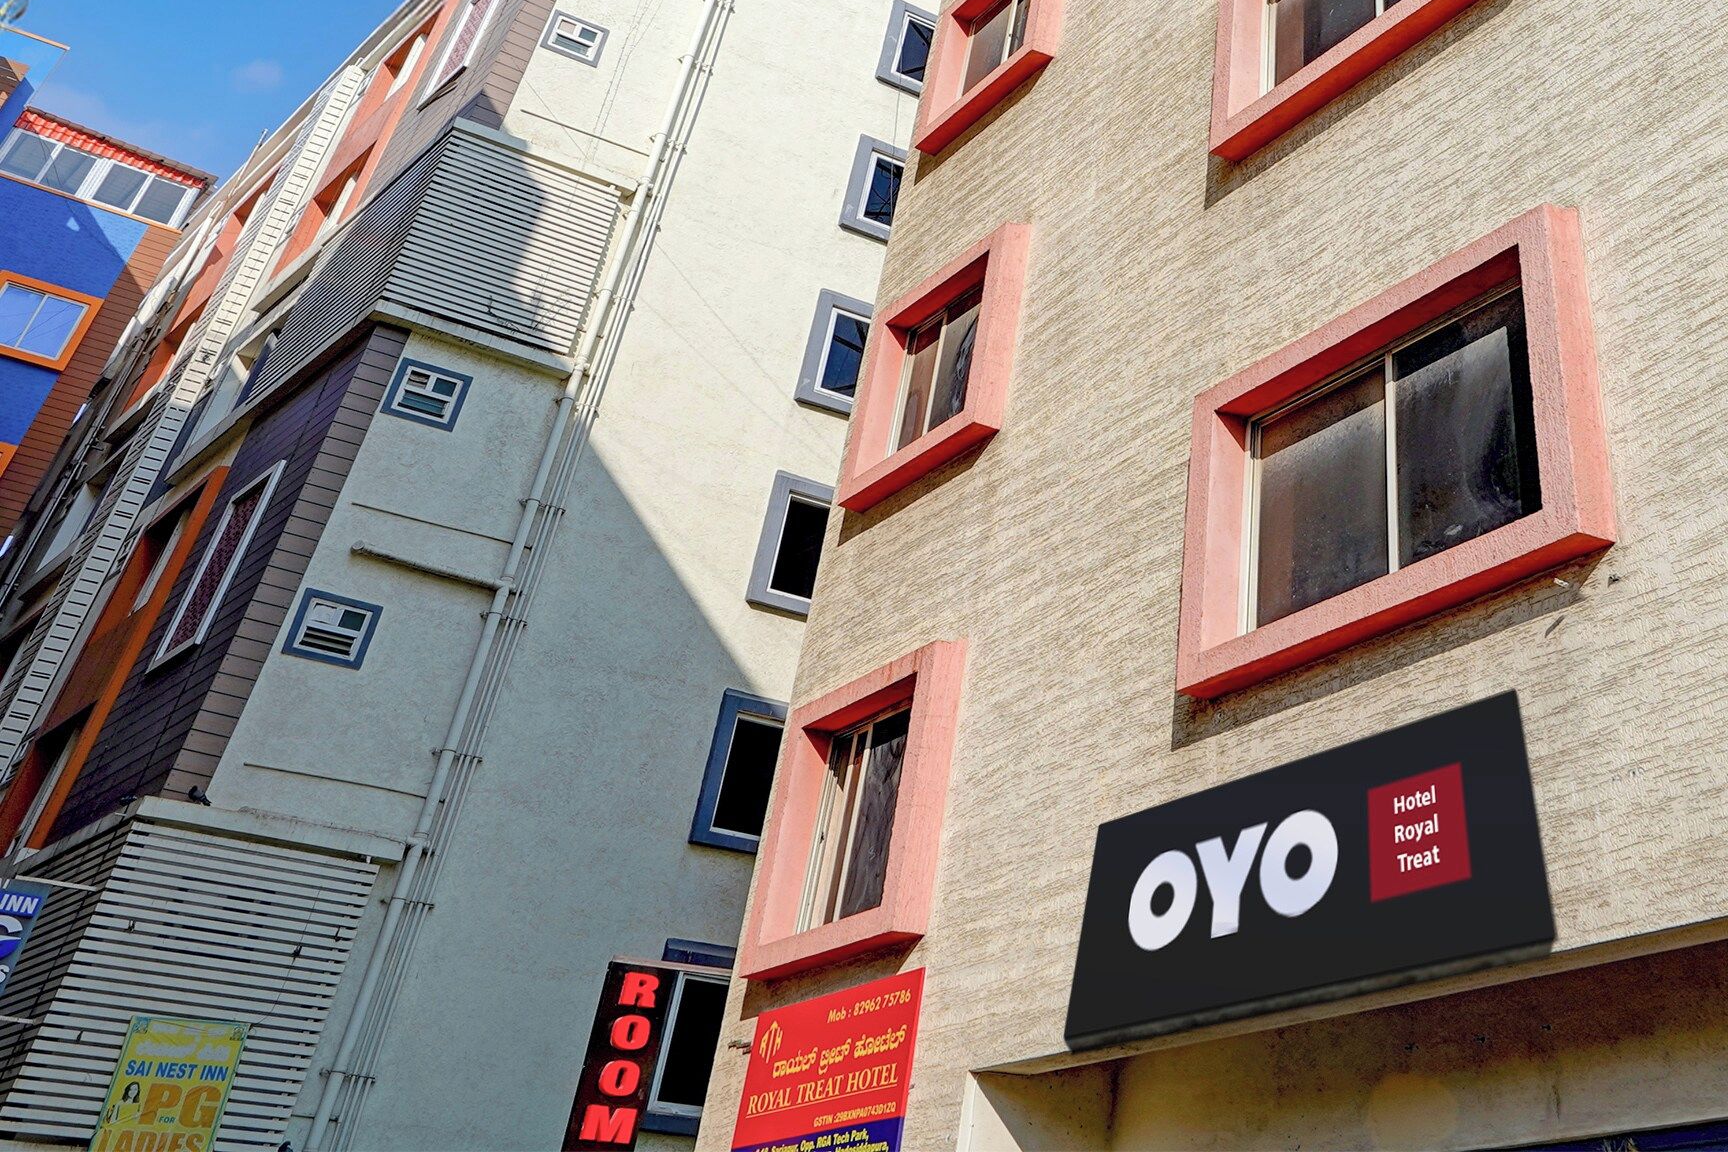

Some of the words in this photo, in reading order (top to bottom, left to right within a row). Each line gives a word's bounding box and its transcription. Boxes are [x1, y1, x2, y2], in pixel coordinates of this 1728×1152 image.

[1393, 785, 1437, 814] Hotel
[1394, 814, 1439, 846] Royal
[1397, 846, 1441, 874] Treat
[1128, 809, 1339, 952] OYO
[827, 1006, 846, 1023] Mob
[853, 996, 881, 1016] 82962
[882, 989, 911, 1008] 75786
[125, 1059, 153, 1077] SAI
[155, 1062, 197, 1079] NEST
[200, 1064, 229, 1081] INN
[578, 971, 660, 1145] ROOM
[746, 1088, 792, 1115] ROYAL
[797, 1075, 844, 1103] TREAT
[845, 1063, 898, 1093] HOTEL
[138, 1082, 222, 1128] PG
[158, 1116, 176, 1124] FOR
[813, 1114, 833, 1127] GSTIN
[833, 1131, 850, 1145] Tech
[851, 1128, 869, 1142] Park,
